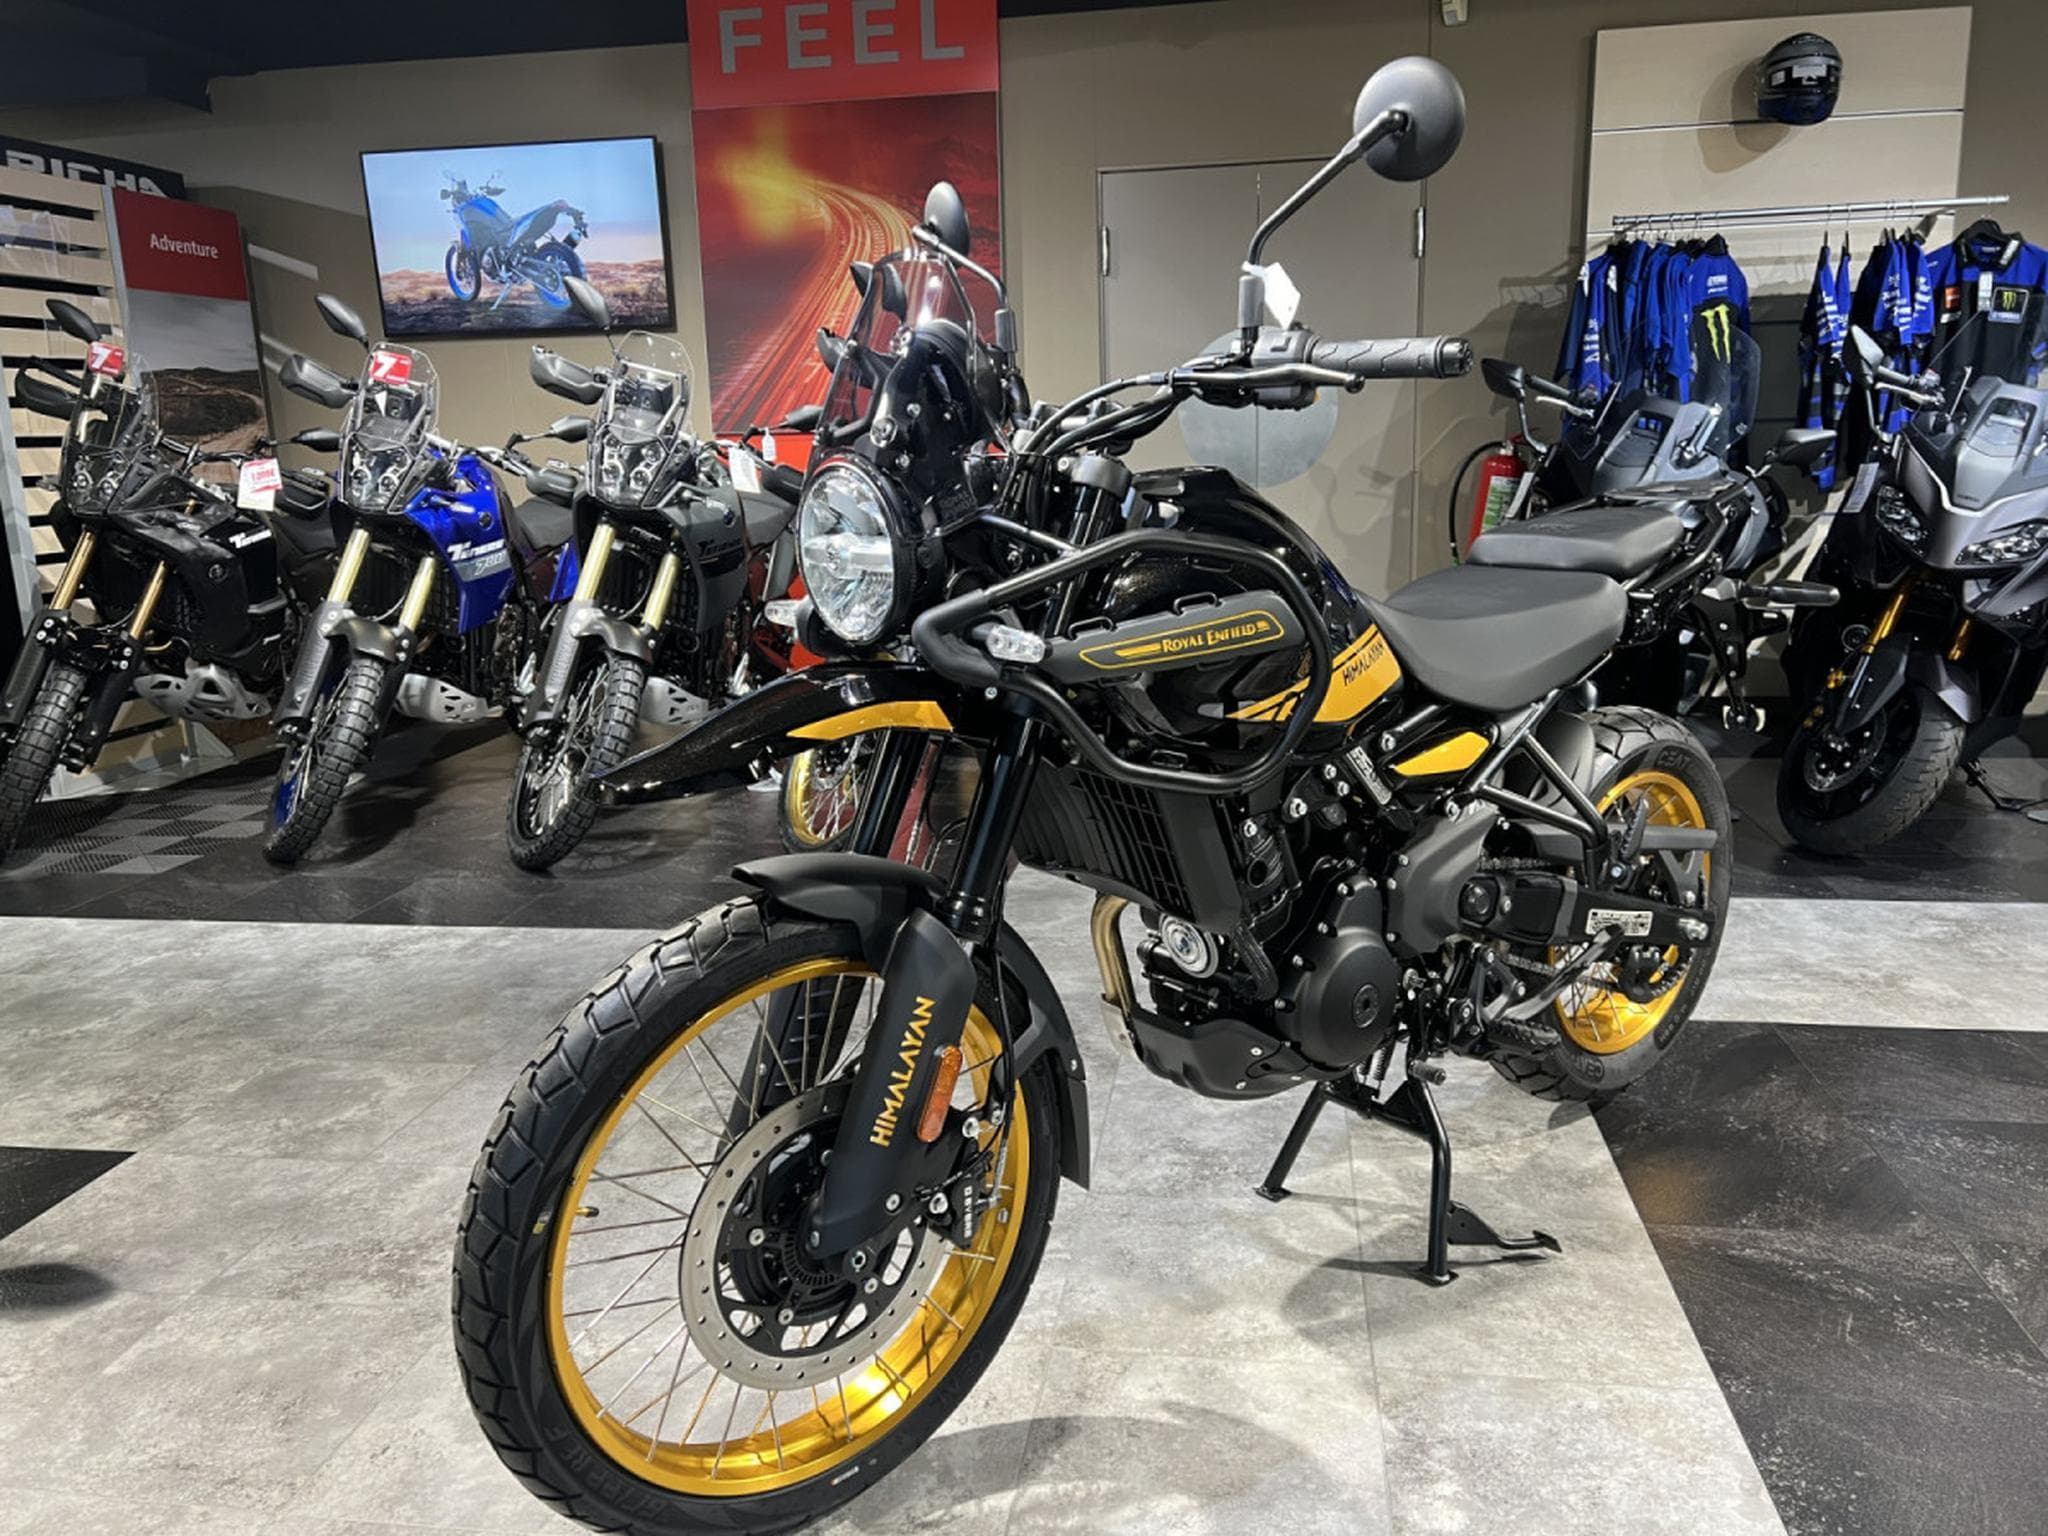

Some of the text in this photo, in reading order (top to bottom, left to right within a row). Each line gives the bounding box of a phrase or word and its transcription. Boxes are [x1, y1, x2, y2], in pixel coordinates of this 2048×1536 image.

[719, 0, 965, 74] FEEL
[150, 233, 219, 259] Adventure
[1162, 622, 1257, 653] ROYAL ENFIELD
[1342, 639, 1383, 687] HIMALAYAN
[869, 996, 937, 1148] HIMALAYAN
